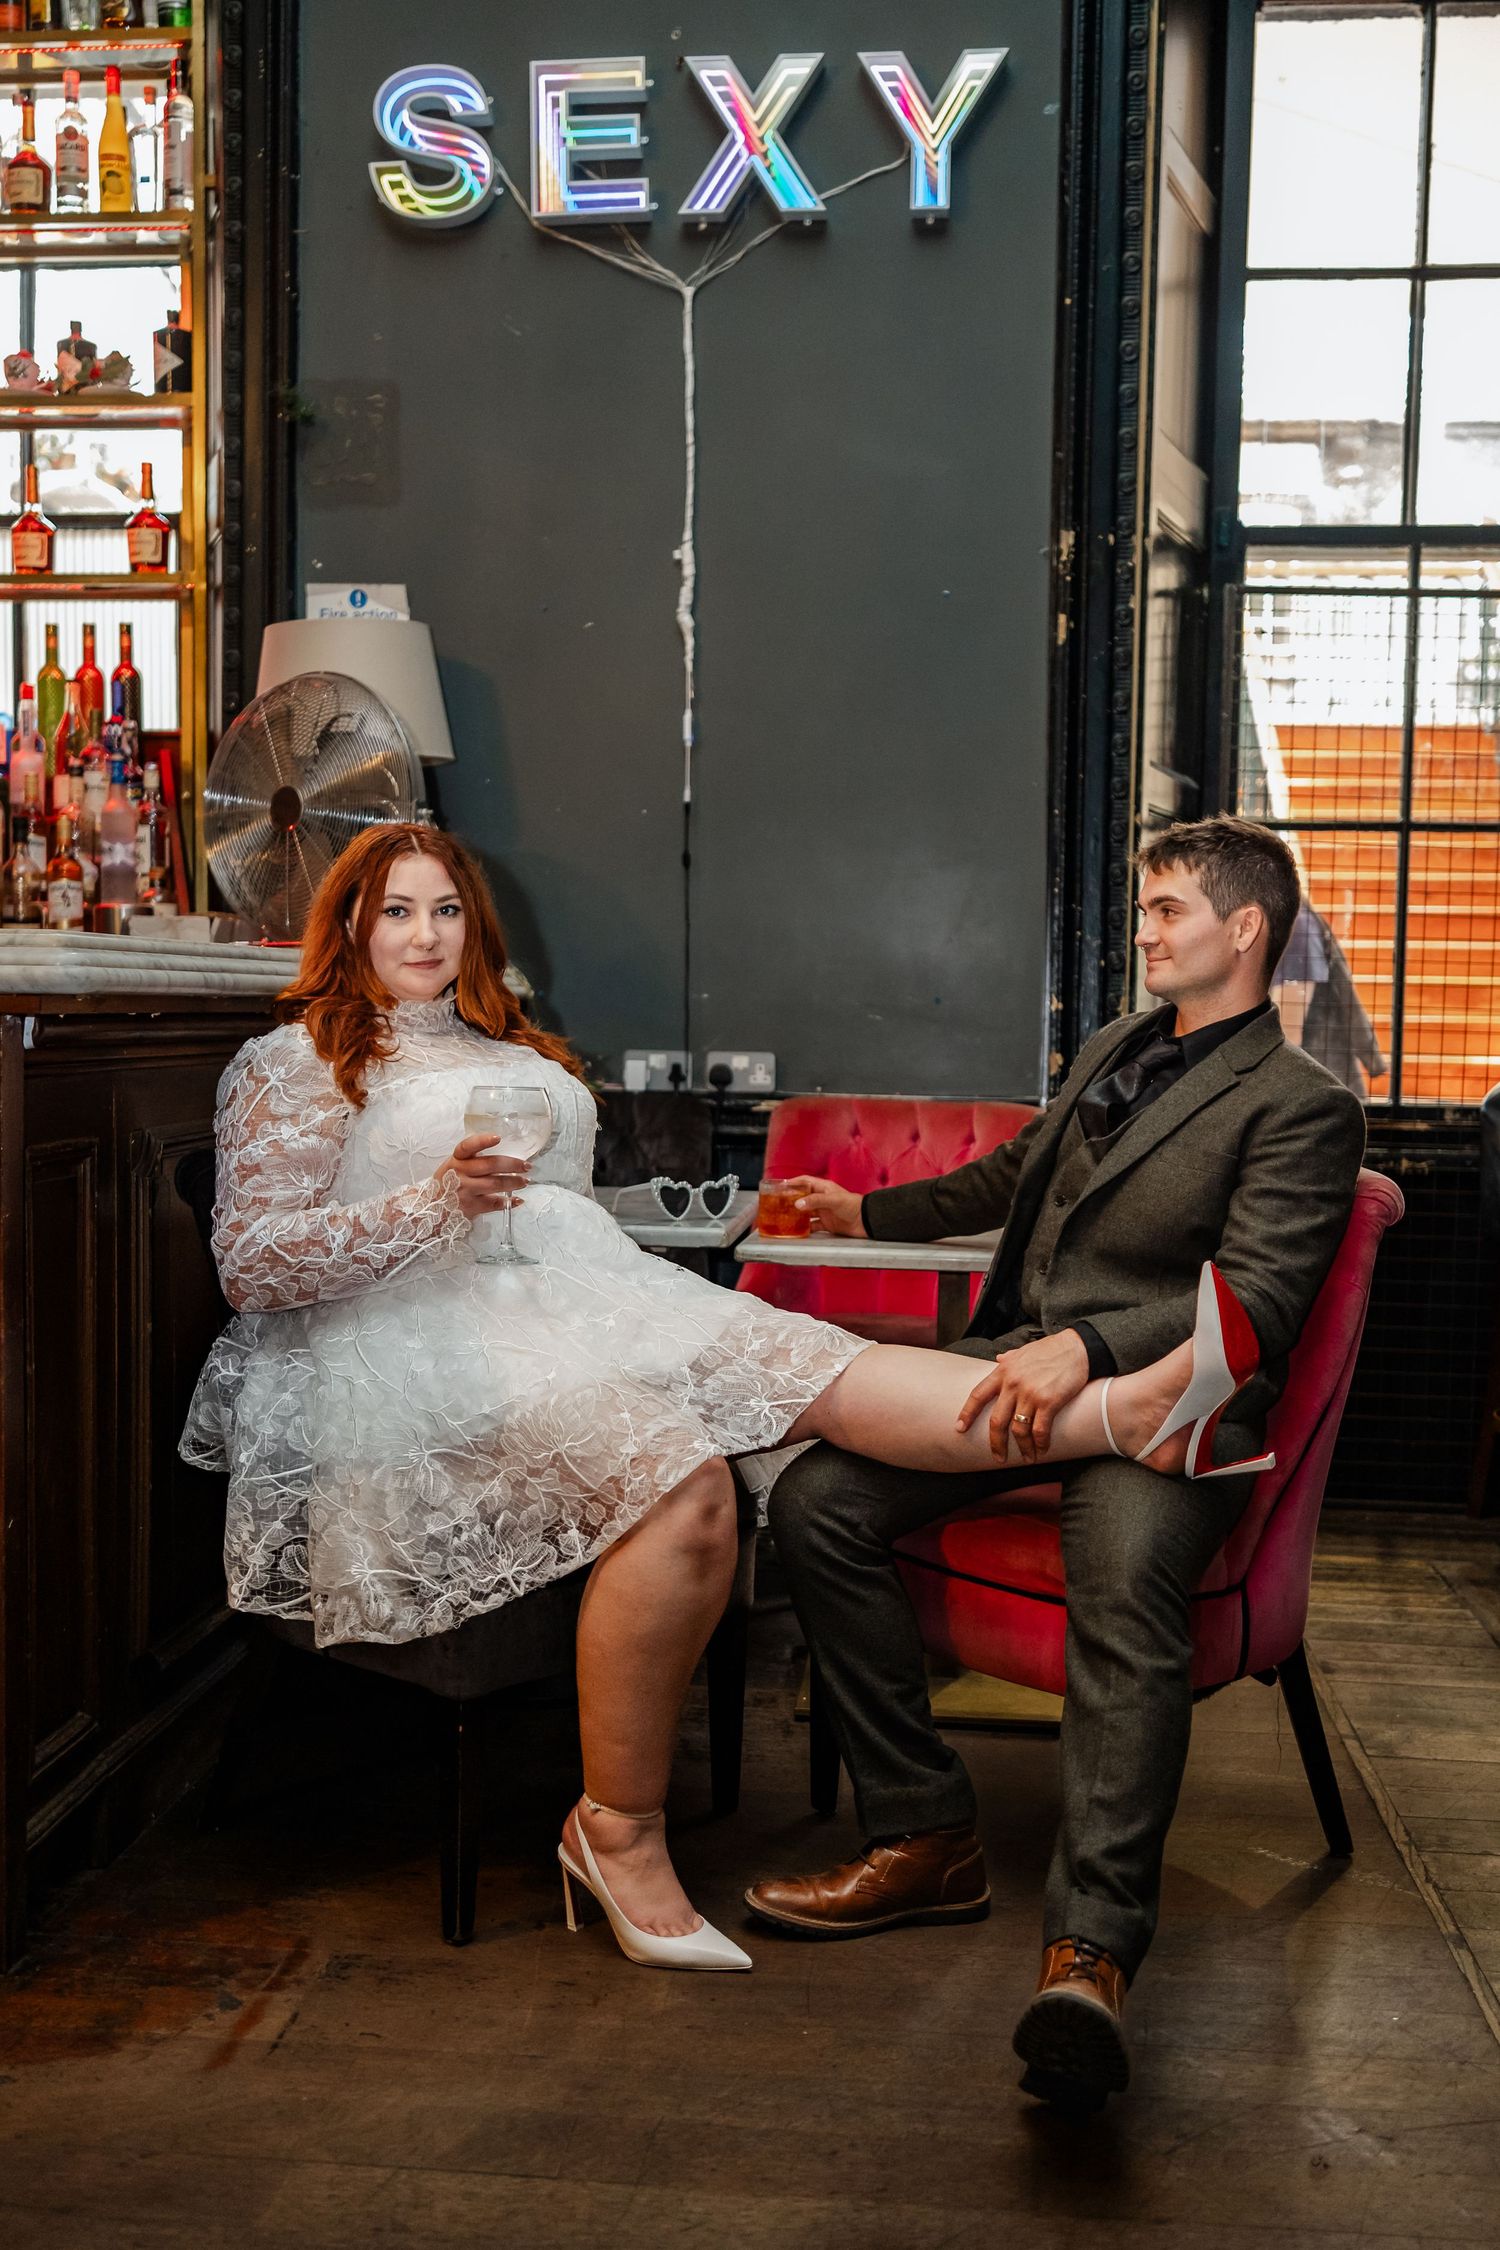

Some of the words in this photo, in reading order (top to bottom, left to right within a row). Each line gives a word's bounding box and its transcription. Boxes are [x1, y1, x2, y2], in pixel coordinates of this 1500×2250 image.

[368, 47, 1010, 229] SEXY
[320, 607, 348, 618] Fire
[353, 607, 399, 619] action
